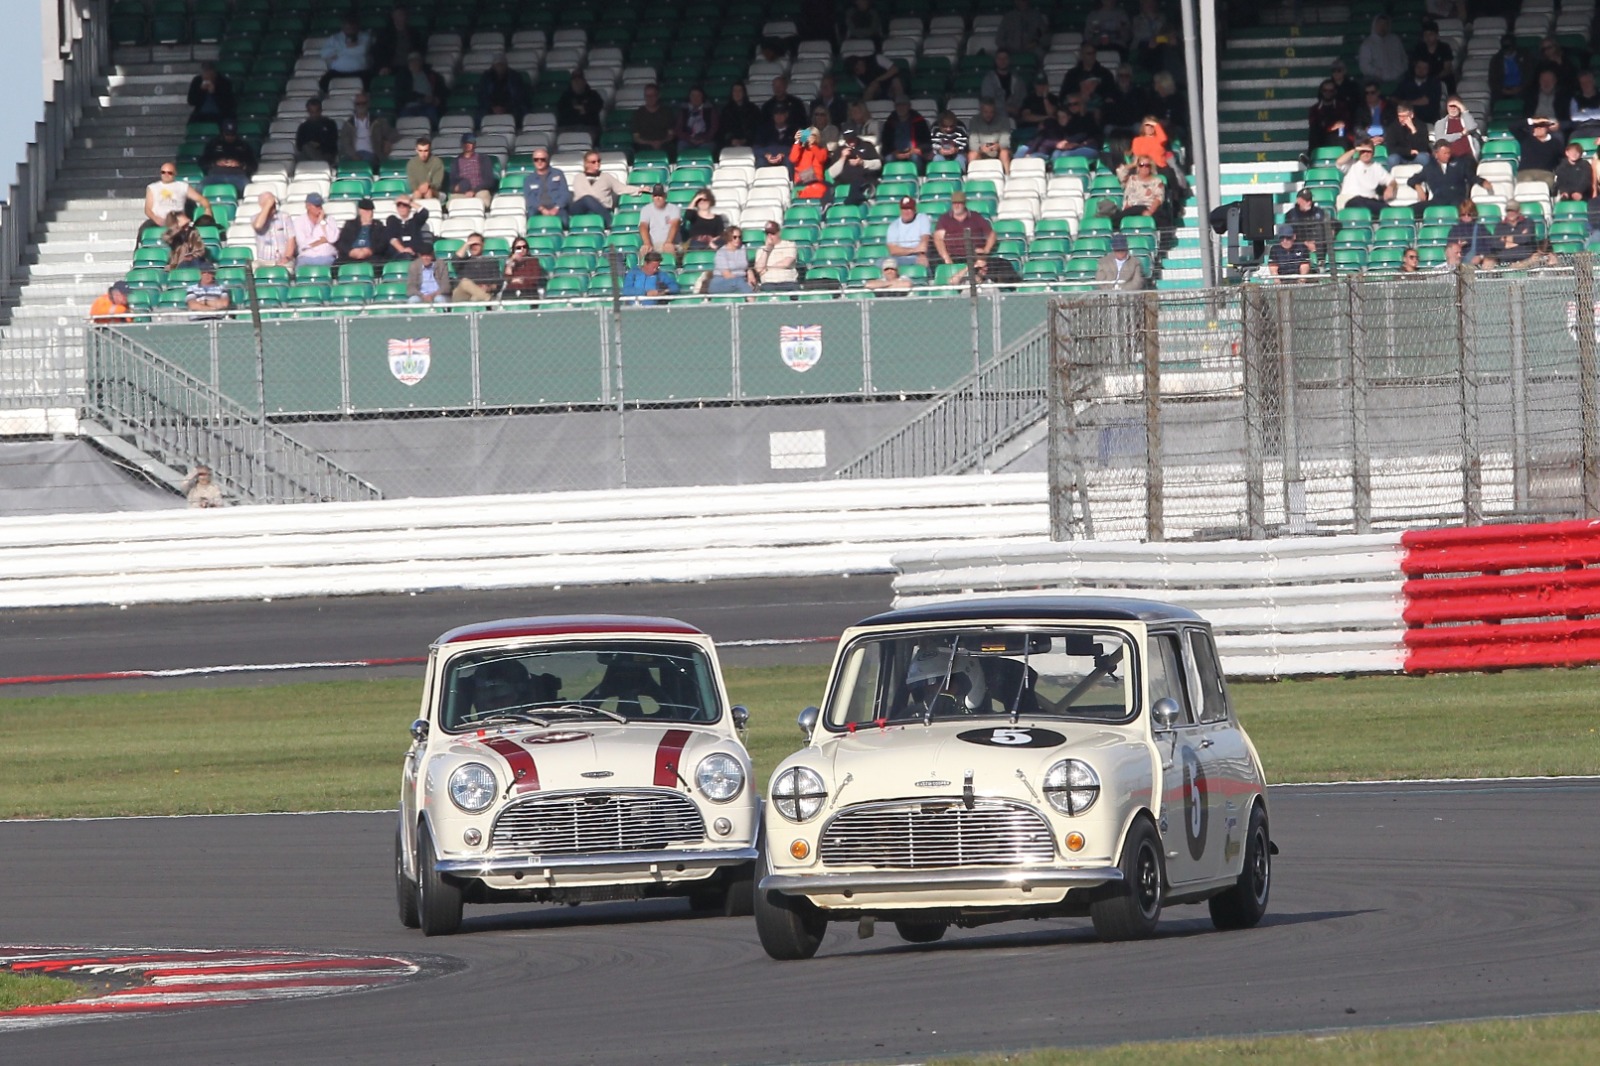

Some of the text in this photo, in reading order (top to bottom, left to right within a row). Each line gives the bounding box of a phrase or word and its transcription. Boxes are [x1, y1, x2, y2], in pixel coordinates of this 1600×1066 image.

[125, 126, 136, 137] N
[1263, 132, 1271, 141] L
[123, 147, 134, 157] M
[116, 168, 123, 178] L
[1250, 173, 1258, 185] J
[107, 189, 116, 198] K
[99, 210, 108, 221] J
[89, 232, 99, 242] H
[990, 728, 1032, 745] 5
[1188, 760, 1202, 838] 5
